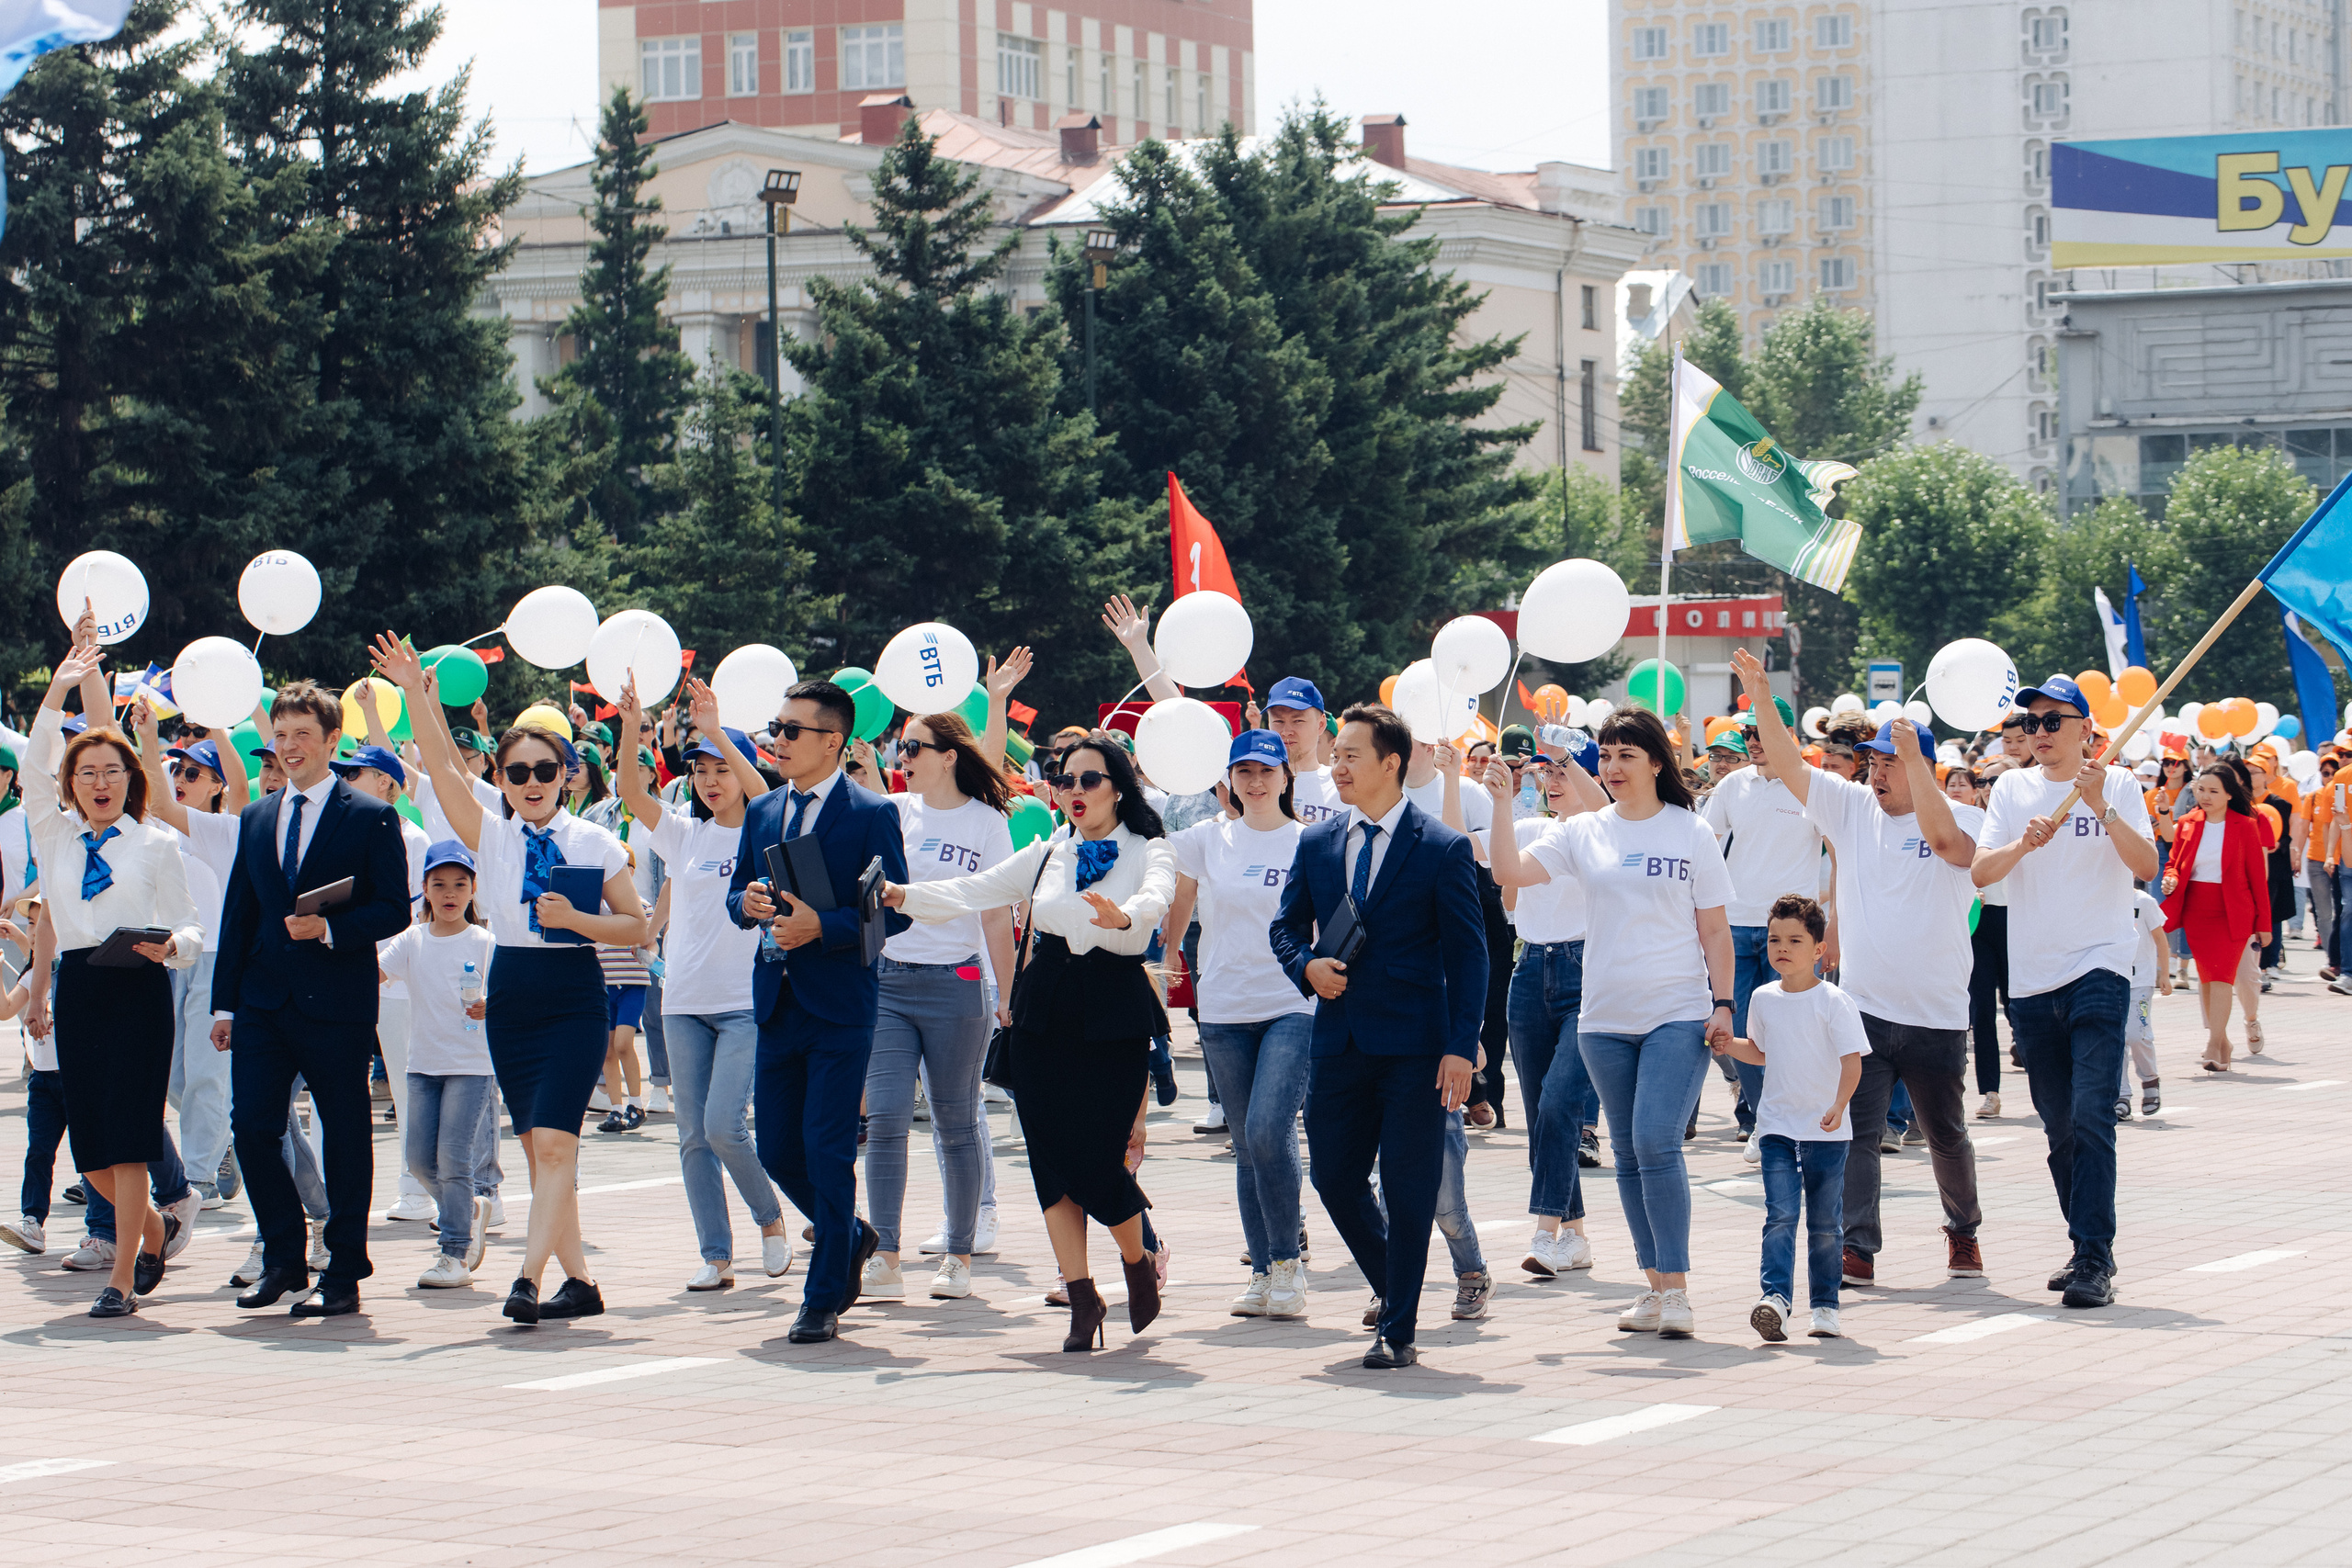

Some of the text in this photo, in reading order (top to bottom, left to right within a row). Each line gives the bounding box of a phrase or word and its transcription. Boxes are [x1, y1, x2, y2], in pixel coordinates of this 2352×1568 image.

[2216, 150, 2352, 246] Бу
[97, 613, 136, 637] ВТБ
[920, 647, 944, 688] ВТБ
[1997, 669, 2017, 710] ВТБ
[1775, 807, 1800, 816] РОССИЯ
[2075, 816, 2109, 837] ВТ
[938, 843, 981, 873] ВТБ
[1646, 857, 1691, 881] ВТБ
